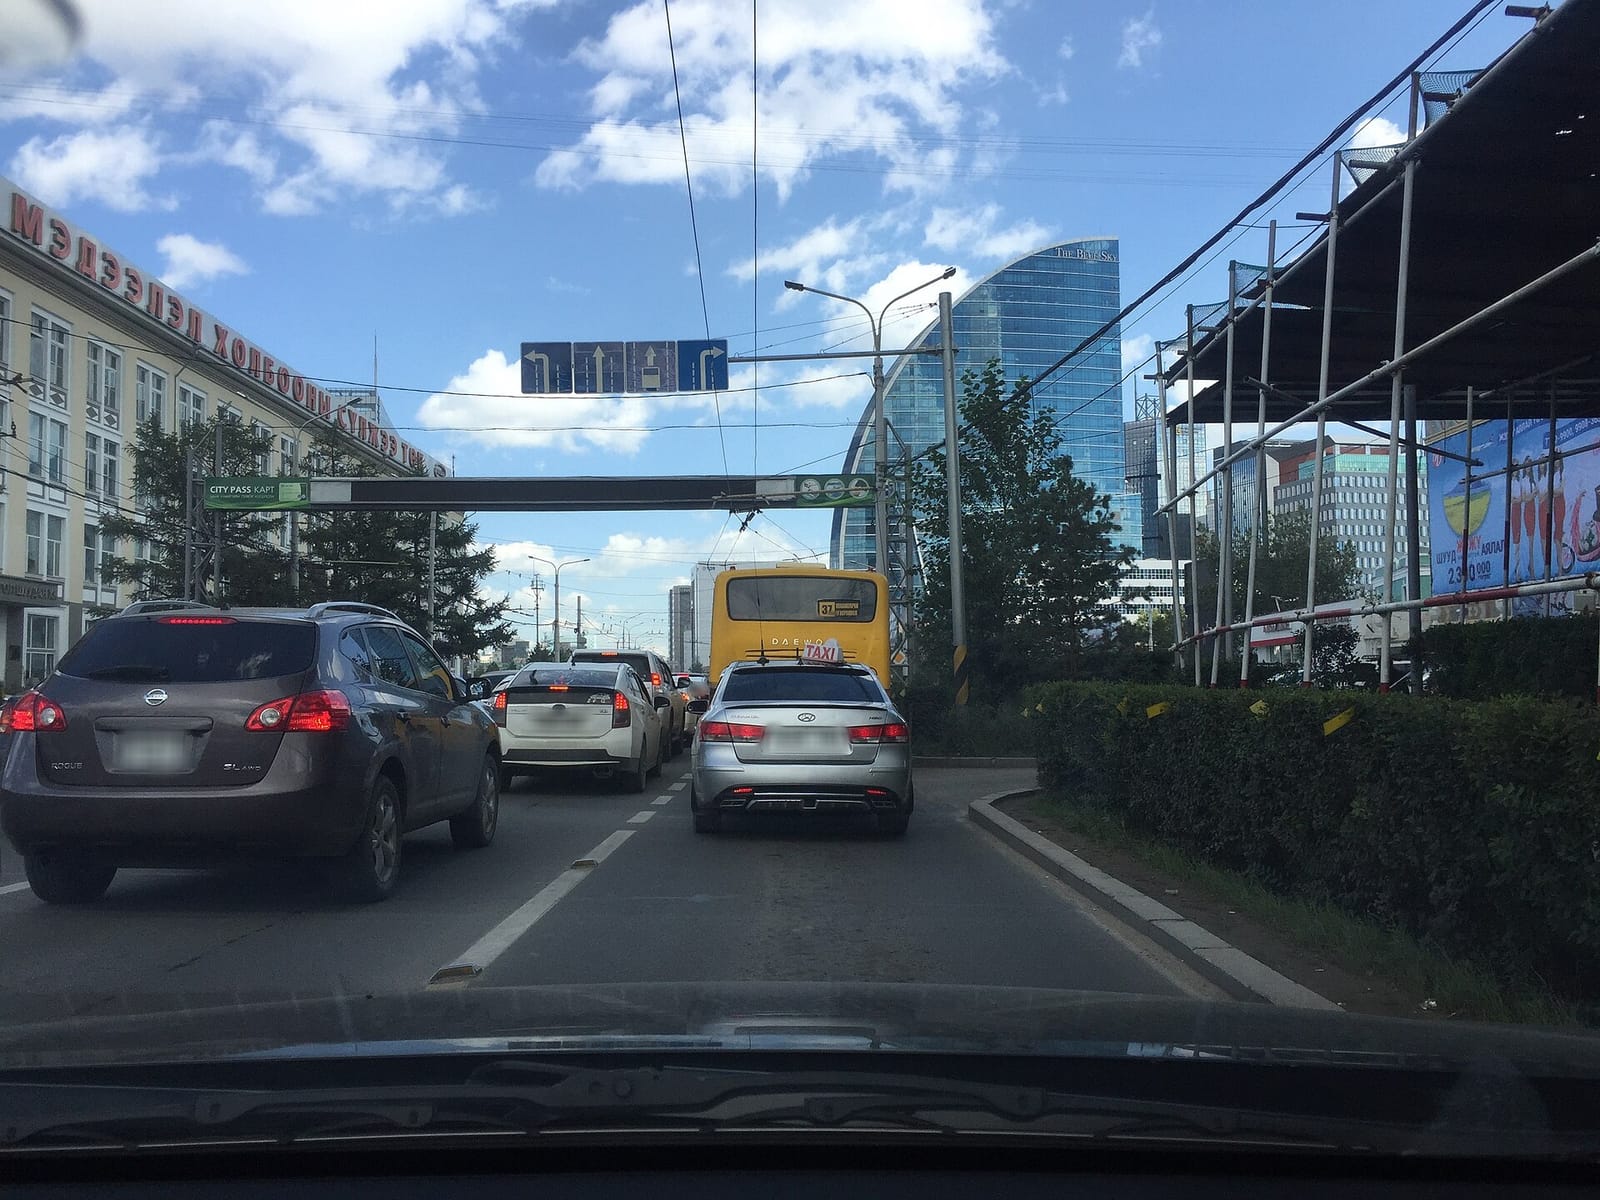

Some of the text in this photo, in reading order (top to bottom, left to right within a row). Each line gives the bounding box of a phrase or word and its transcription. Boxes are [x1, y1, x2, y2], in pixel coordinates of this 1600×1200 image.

[11, 193, 204, 343] МЭДЭЭЛЭЛ
[214, 324, 331, 419] ХОЛБООНЫ
[210, 486, 229, 494] CITY
[230, 486, 251, 494] PASS
[821, 604, 833, 615] 37
[771, 638, 823, 647] DAEWO
[806, 644, 836, 661] TAXI
